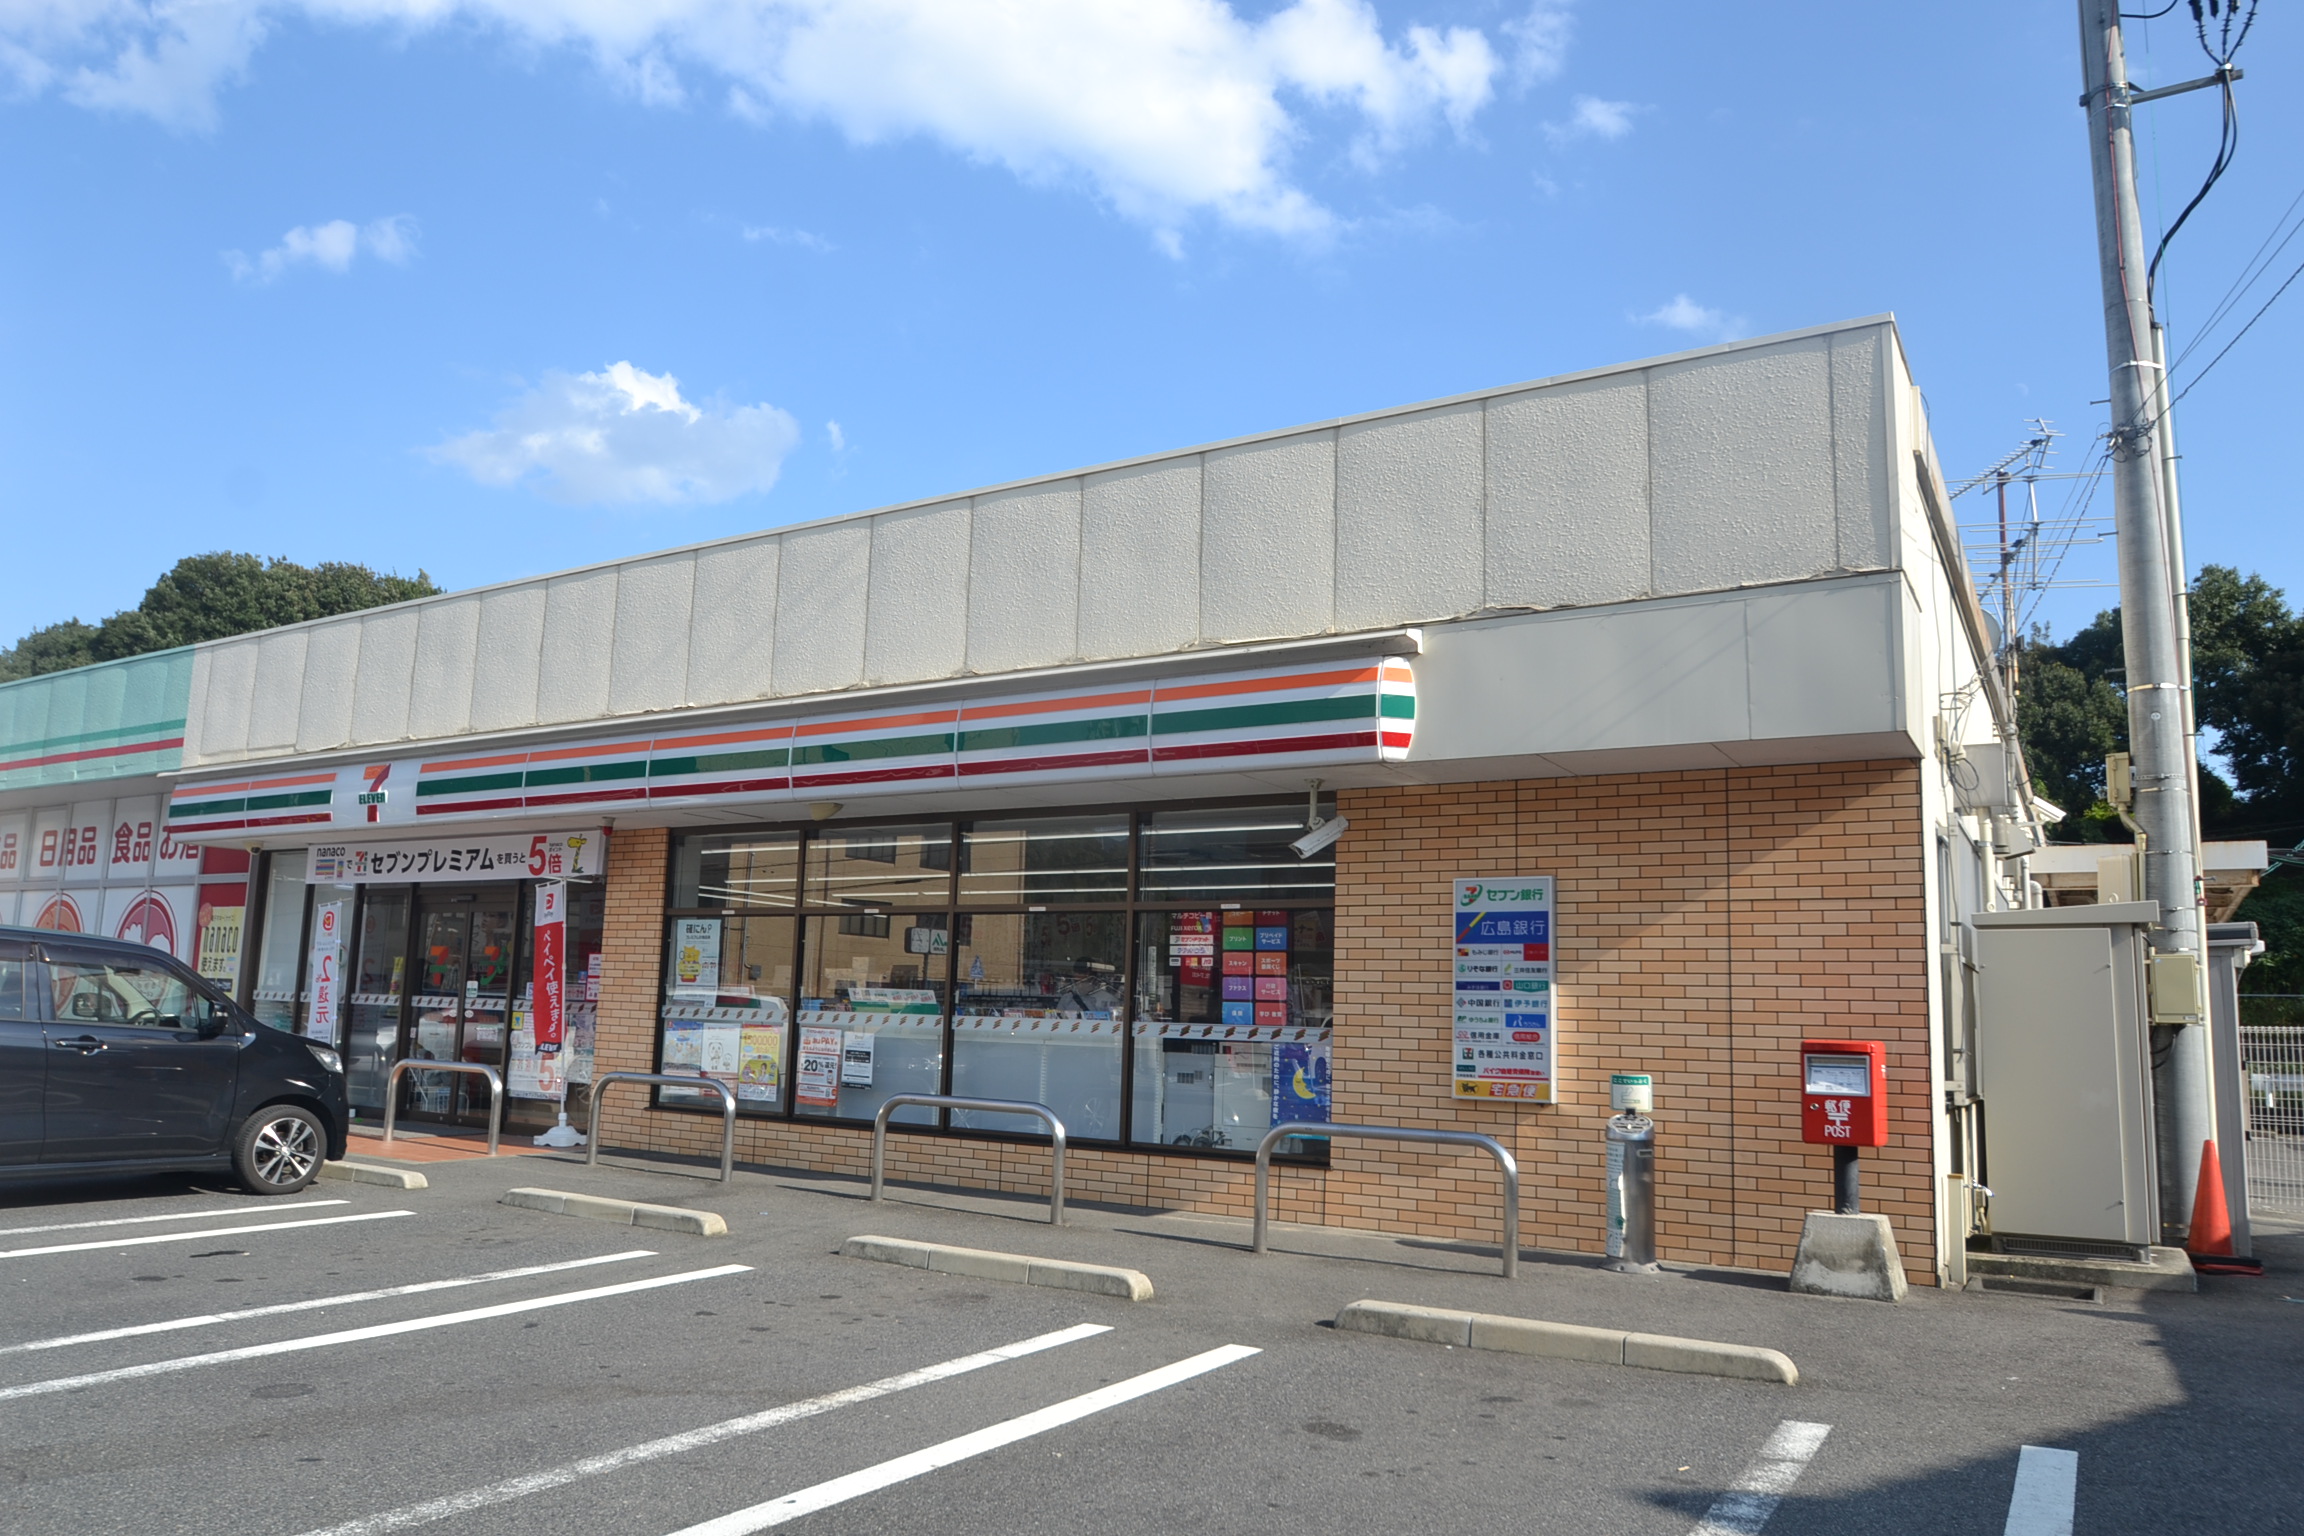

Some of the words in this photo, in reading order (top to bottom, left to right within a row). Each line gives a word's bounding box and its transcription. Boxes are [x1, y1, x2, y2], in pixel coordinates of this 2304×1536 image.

[363, 763, 391, 823] 7
[39, 826, 97, 867] 日用品
[112, 822, 152, 864] 食品
[316, 846, 346, 857] nanaco
[370, 847, 494, 874] セブンプレミアム
[496, 852, 526, 864] を買うと
[528, 835, 547, 876] 5
[548, 854, 562, 874] 倍
[1487, 889, 1543, 901] セブン銀行
[1481, 920, 1545, 936] 広島銀行
[203, 926, 239, 953] nanaco
[1467, 965, 1498, 973] りそな銀行
[543, 930, 563, 1039] ペイペイ使えます。
[1468, 999, 1500, 1008] 中国銀行
[1514, 1000, 1548, 1009] 伊予銀行
[1470, 1032, 1500, 1040] 信用金庫
[1478, 1050, 1543, 1060] 各種公共料金窓口
[1490, 1083, 1538, 1097] 宅急便
[1825, 1100, 1851, 1114] 郵便
[1824, 1125, 1851, 1138] POST
